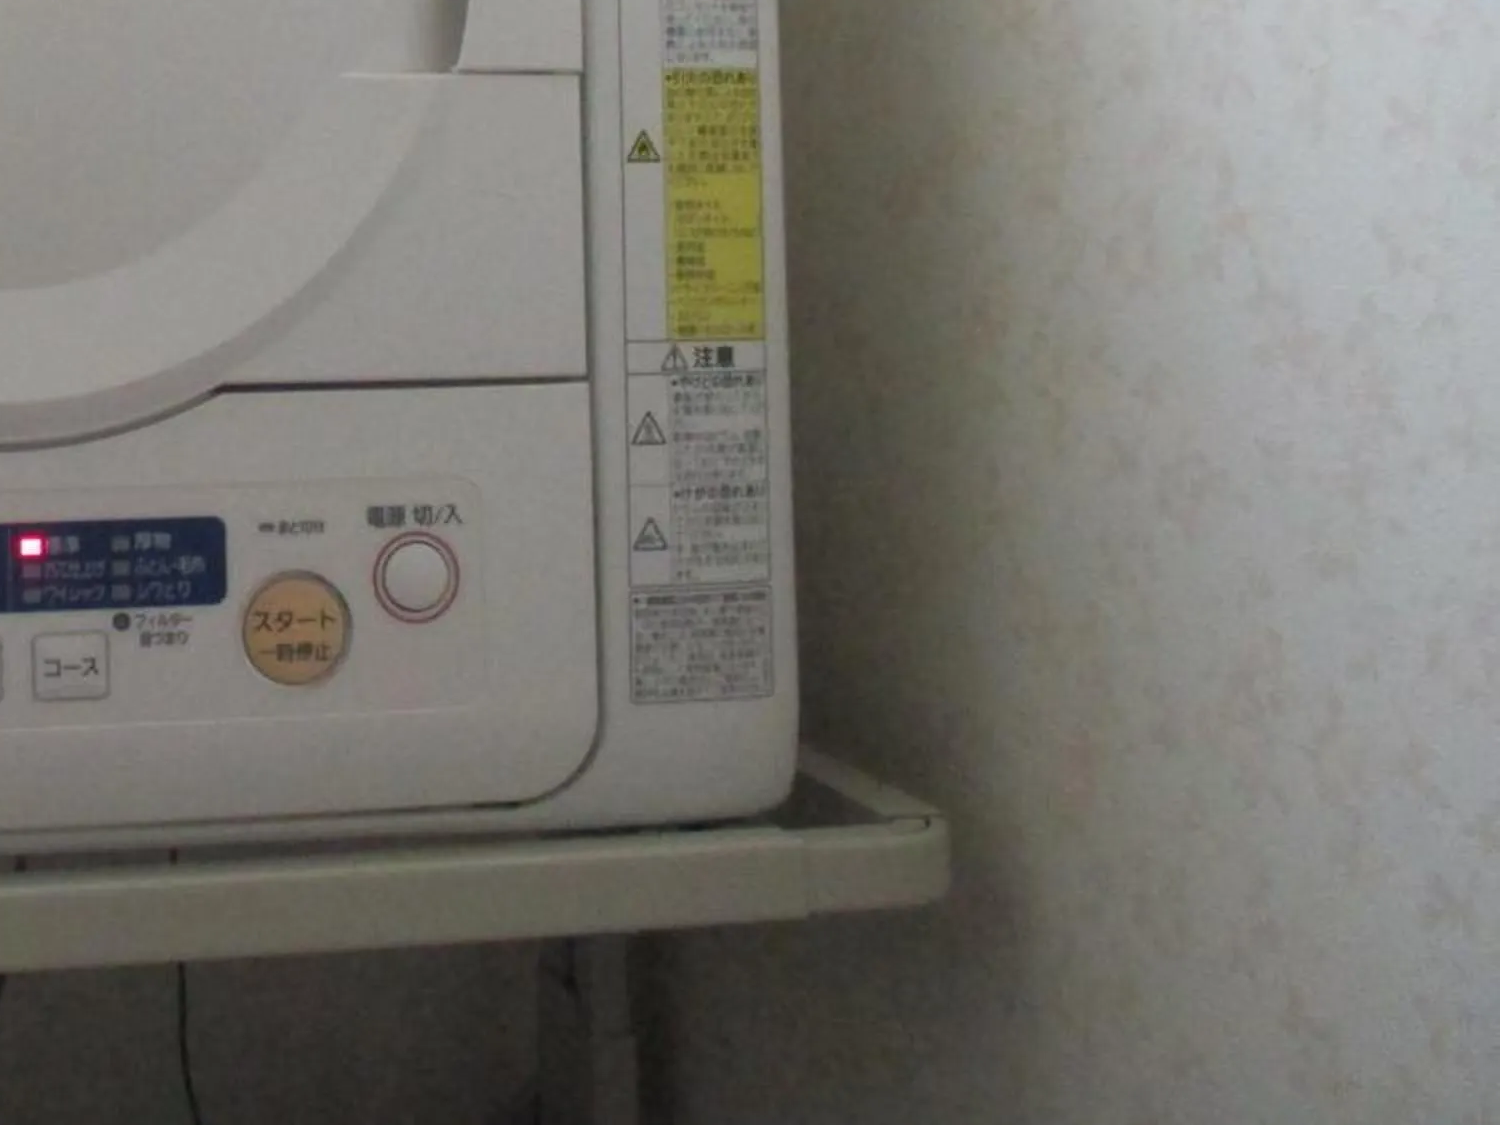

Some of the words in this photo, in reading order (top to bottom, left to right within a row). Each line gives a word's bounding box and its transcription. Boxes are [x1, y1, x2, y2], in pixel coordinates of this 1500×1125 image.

[252, 607, 337, 633] スタート
[43, 656, 100, 678] コース
